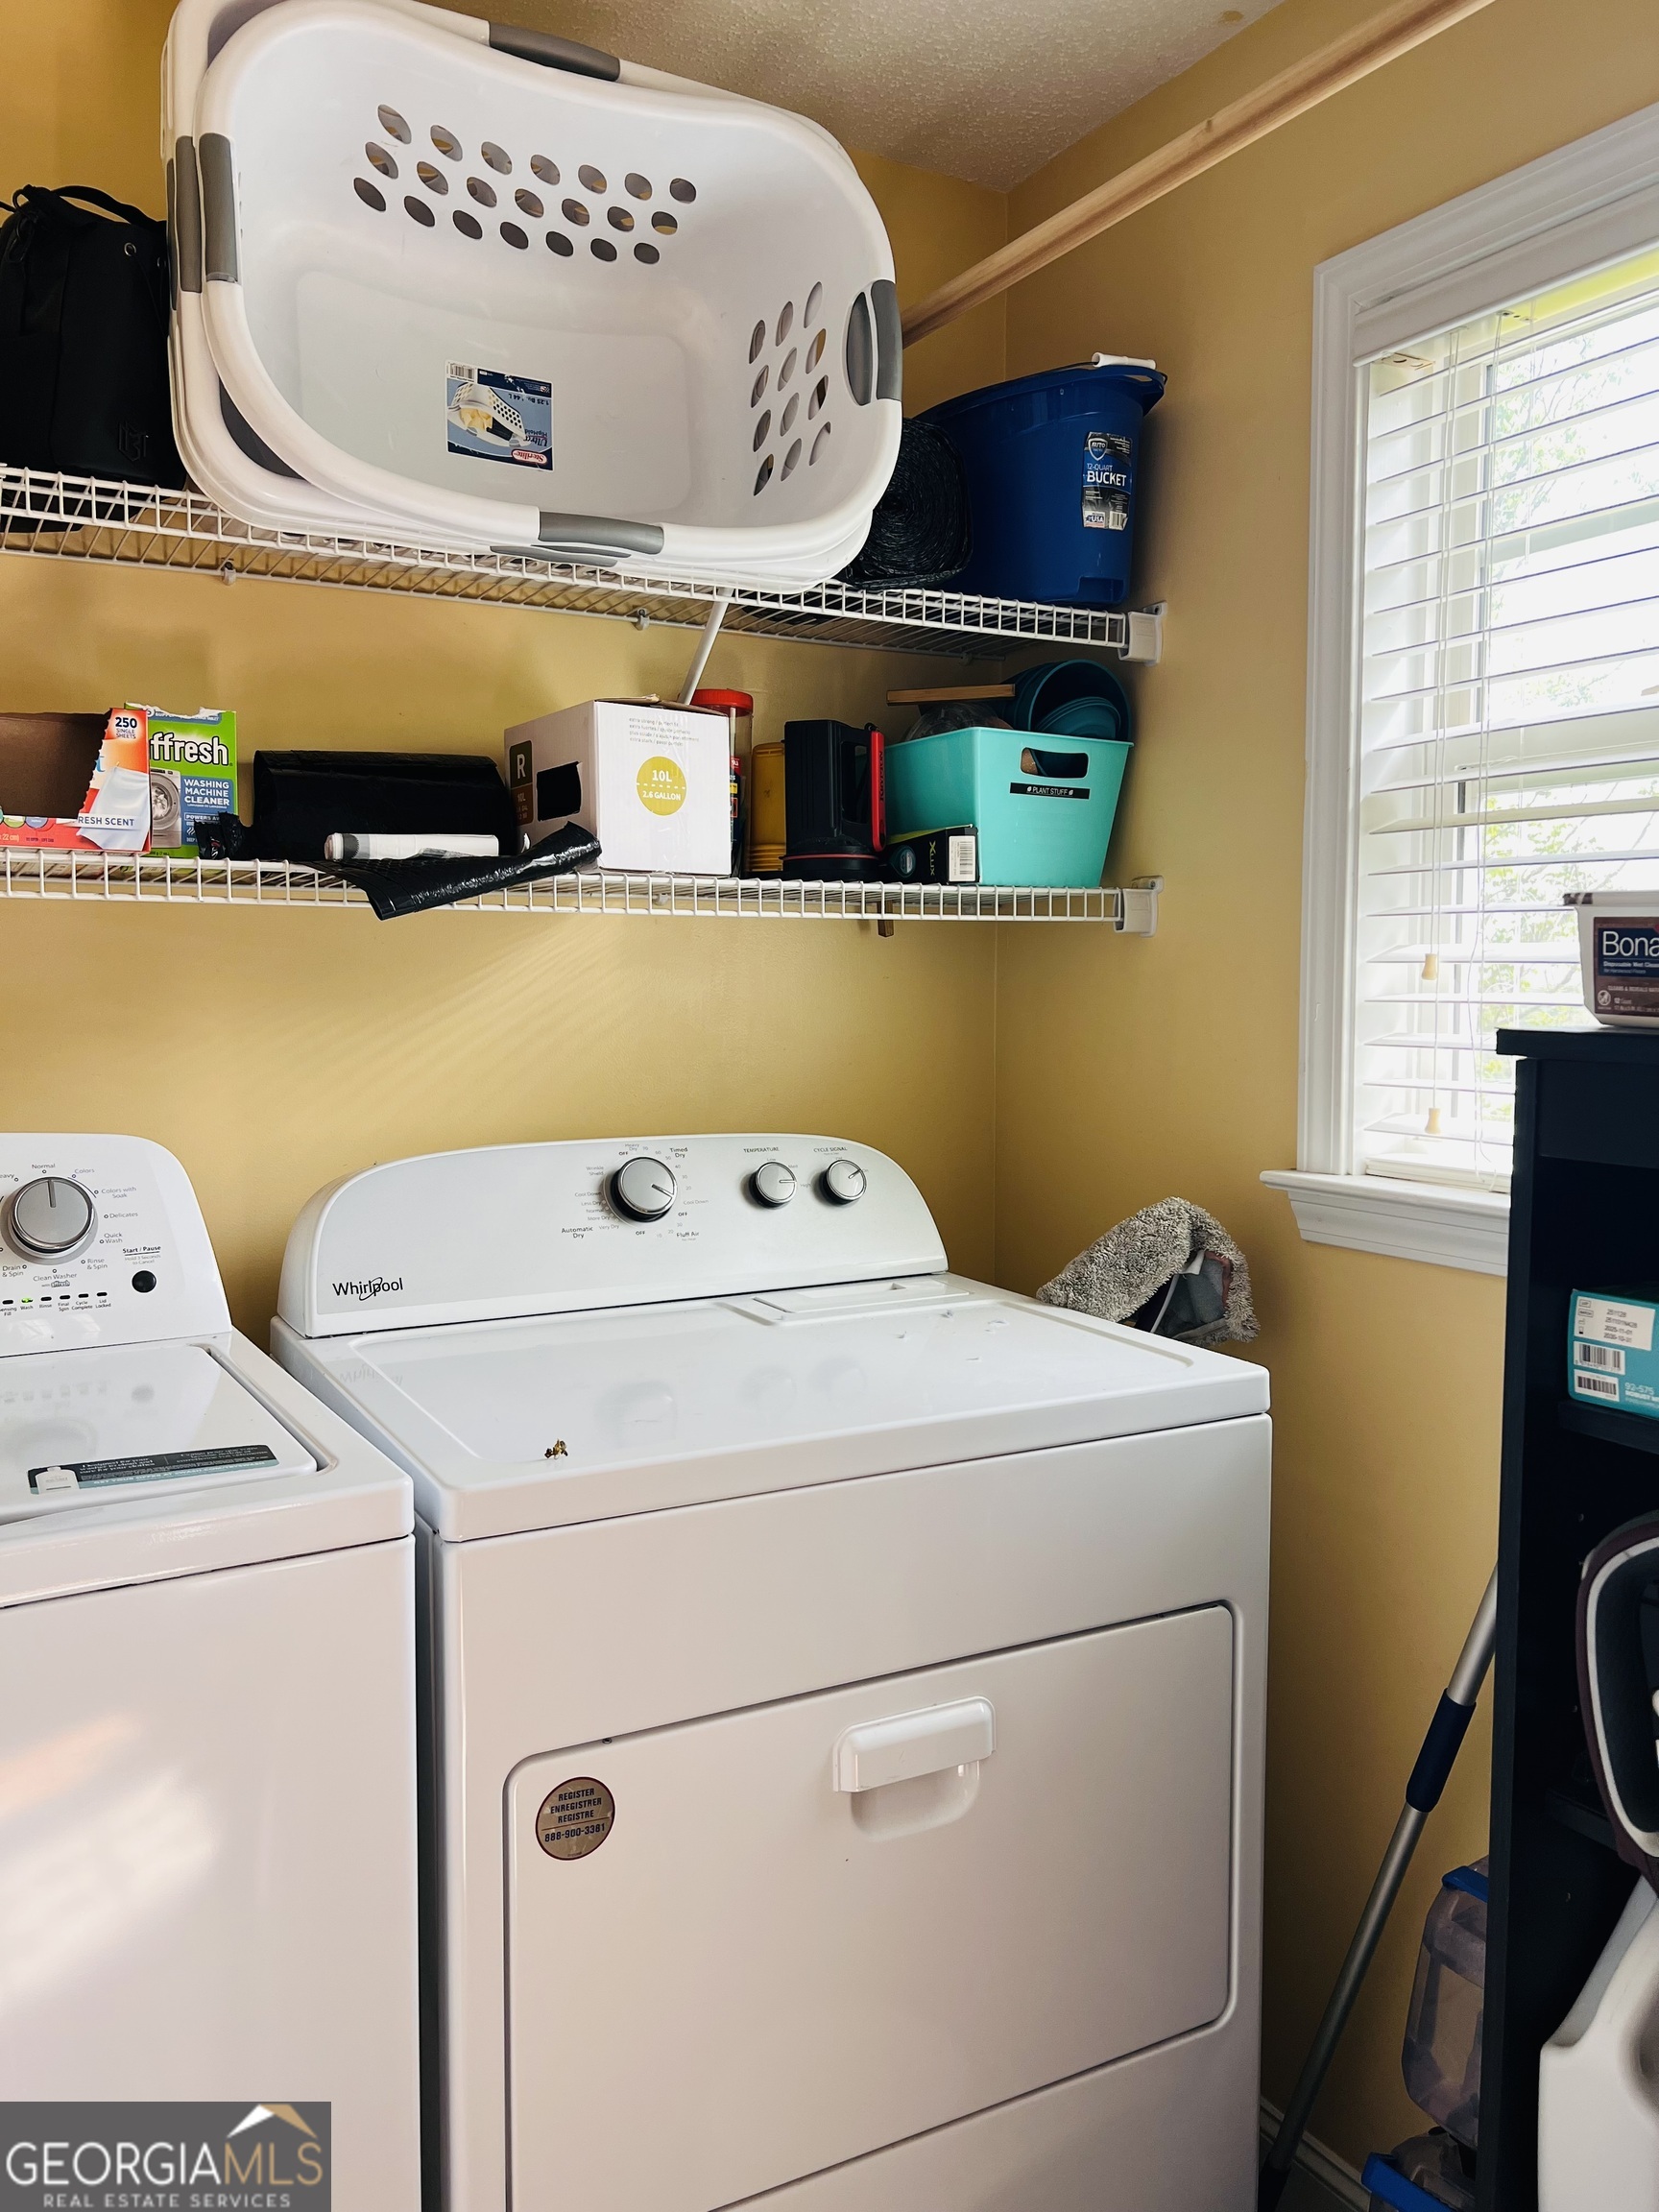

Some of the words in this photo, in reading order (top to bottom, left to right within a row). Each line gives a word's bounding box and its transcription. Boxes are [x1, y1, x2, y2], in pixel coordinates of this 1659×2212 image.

[515, 451, 544, 463] Sterilite
[1086, 463, 1113, 472] 12-QUART
[1086, 471, 1127, 486] BUCKET
[115, 717, 137, 728] 250
[150, 732, 228, 766] ffresh
[517, 753, 526, 779] R
[652, 769, 672, 782] 10L
[184, 779, 229, 789] WASHING
[185, 788, 229, 797] MACHINE
[654, 792, 681, 801] GALLON
[184, 796, 230, 805] CLEANER
[78, 816, 102, 825] RESH
[105, 817, 134, 826] SCENT
[1602, 931, 1659, 957] Bona
[332, 1277, 403, 1298] Whirlpool
[558, 1788, 595, 1801] REGISTER
[551, 1798, 602, 1814] ENREGISTRER
[558, 1810, 594, 1823] REGISTRE
[545, 1823, 605, 1842] 888-900-3381
